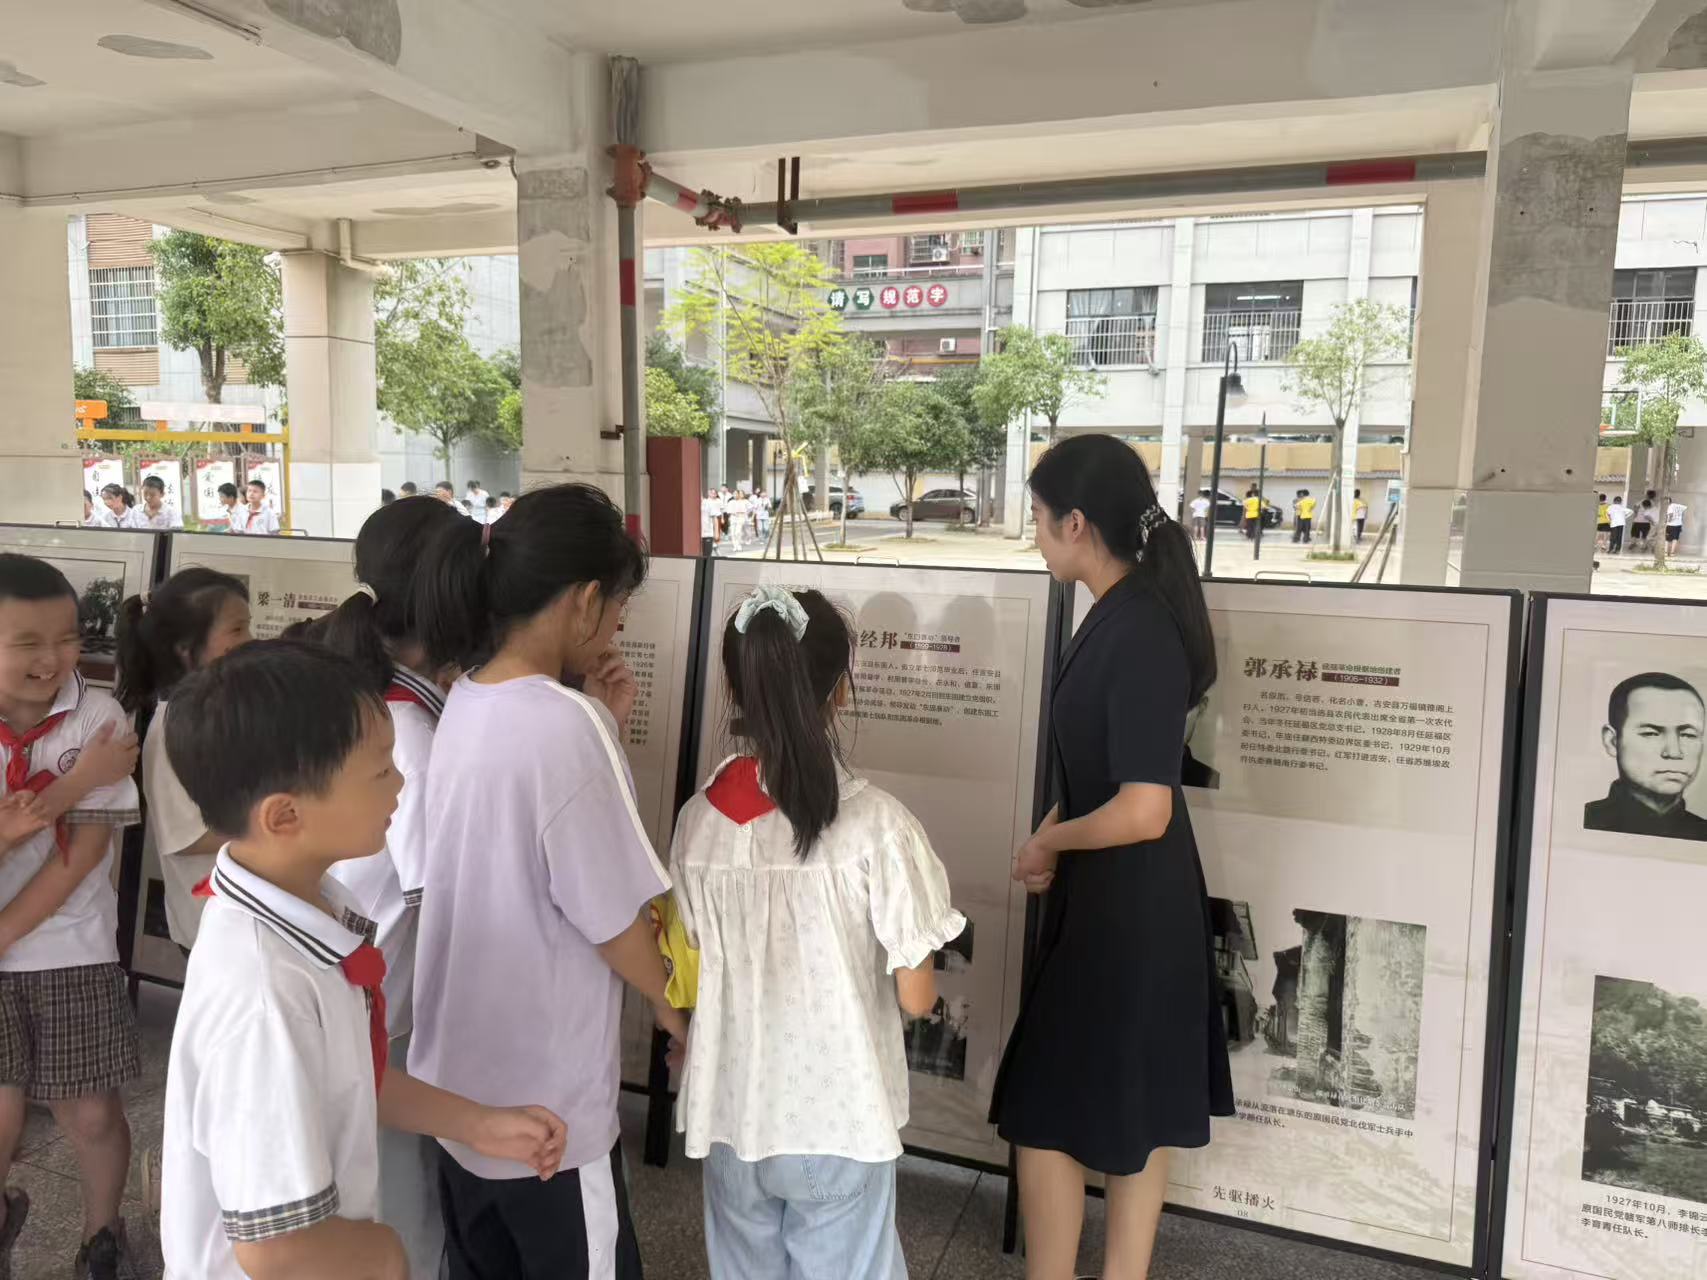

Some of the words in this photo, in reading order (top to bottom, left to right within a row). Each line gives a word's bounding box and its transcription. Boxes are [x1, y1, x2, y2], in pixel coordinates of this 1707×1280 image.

[830, 287, 945, 307] 请写规范字
[1243, 656, 1319, 682] 郭承禄
[1212, 1185, 1275, 1210] 先驱播火
